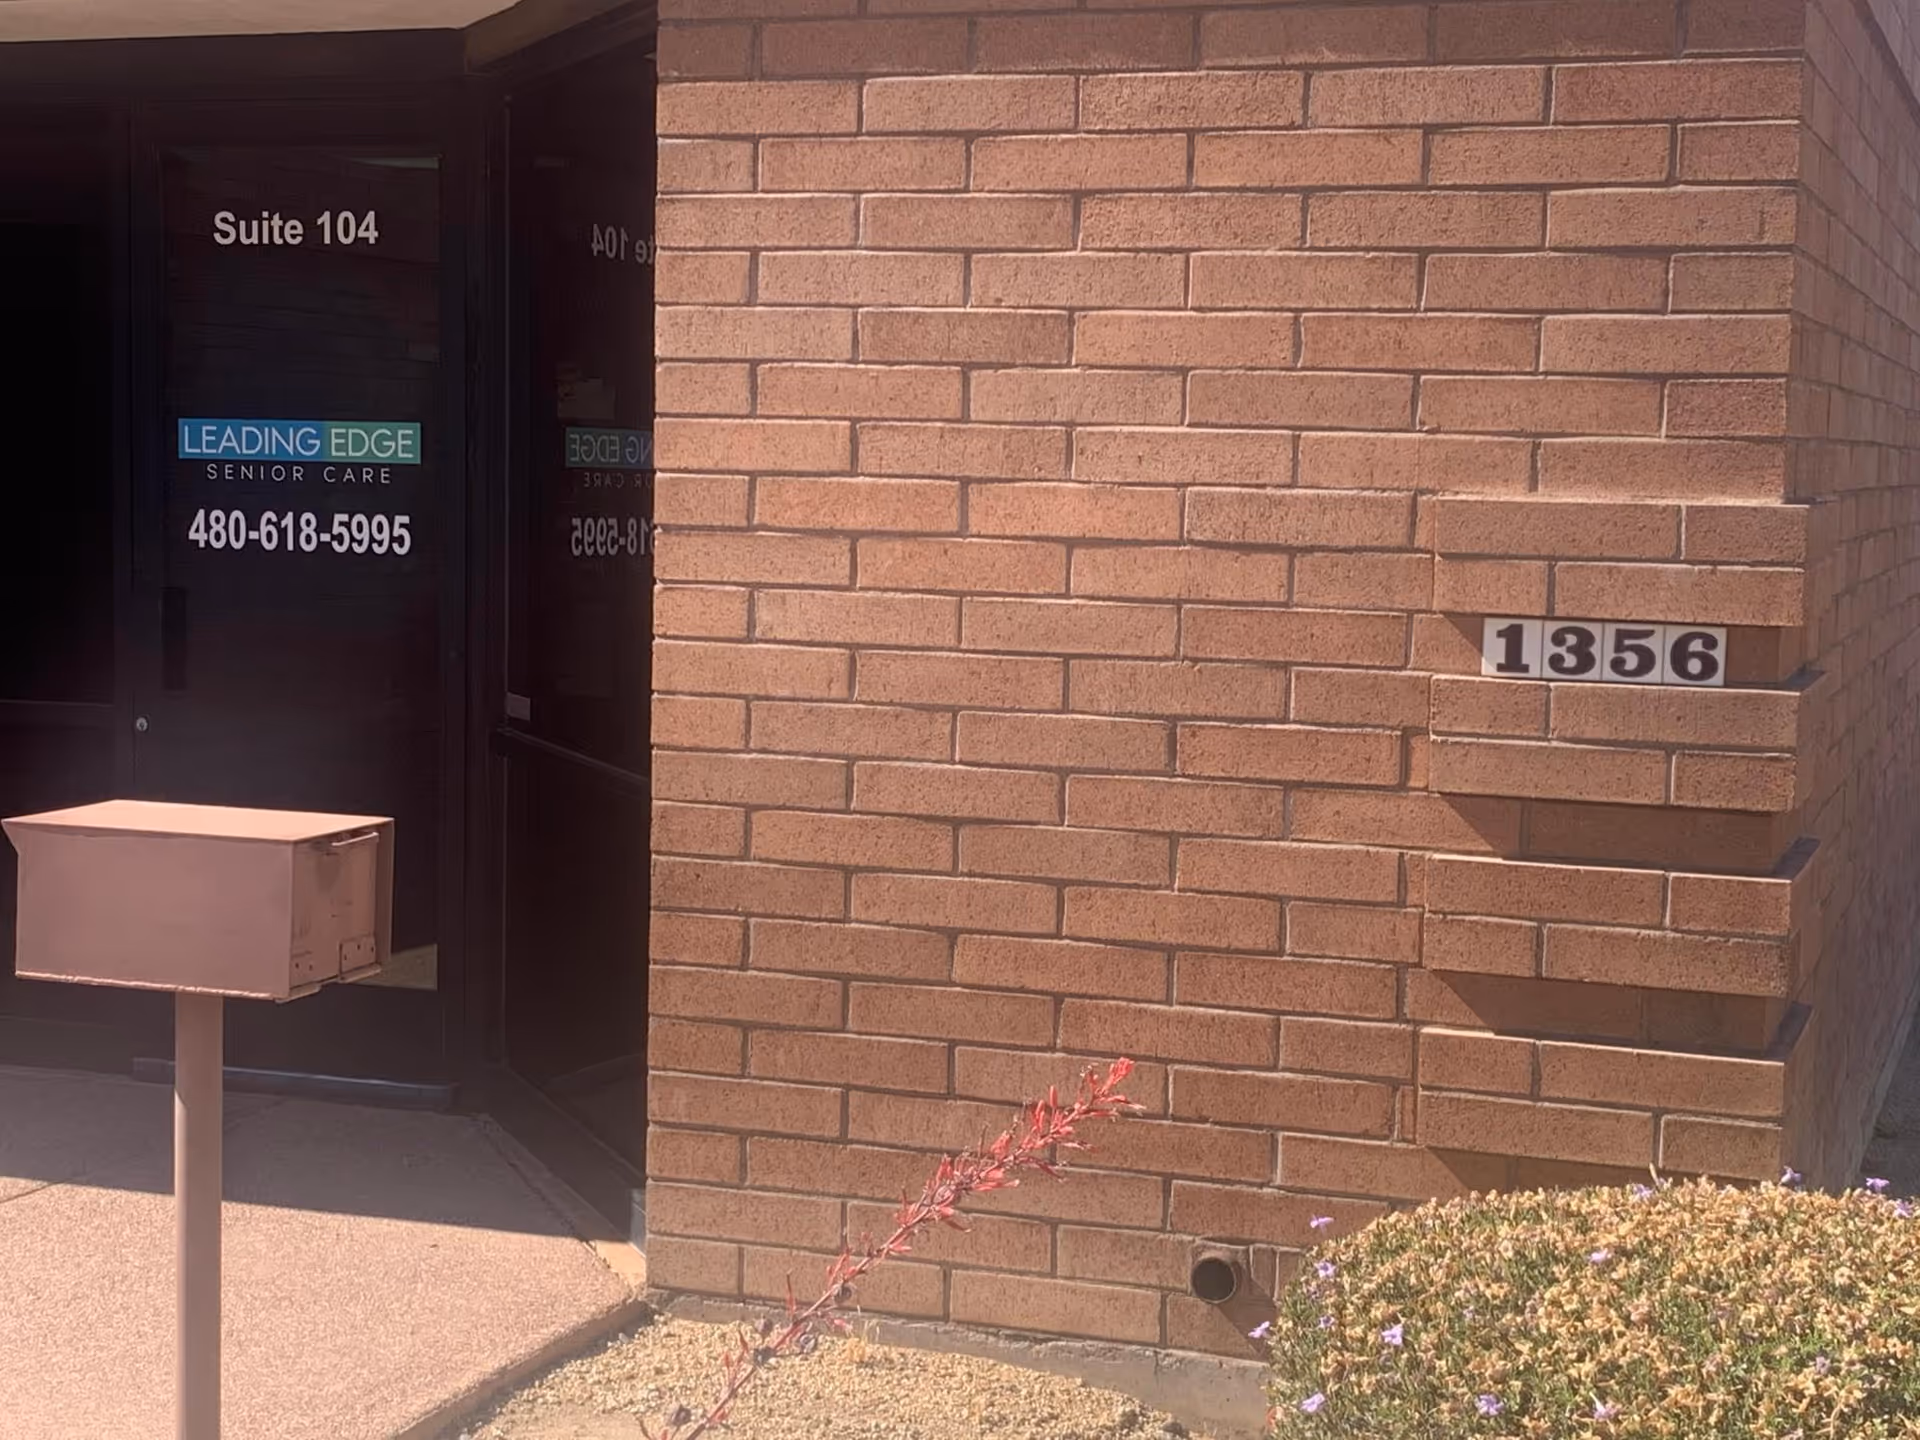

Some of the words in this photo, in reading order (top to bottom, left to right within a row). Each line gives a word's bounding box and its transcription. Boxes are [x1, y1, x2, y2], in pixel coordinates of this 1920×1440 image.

[213, 210, 304, 245] Suite
[316, 210, 379, 245] 104
[184, 425, 320, 456] LEADING
[330, 428, 414, 458] EDGE
[206, 463, 304, 482] SENIOR
[323, 466, 391, 484] CARE
[188, 508, 412, 556] 480-618-5995
[1496, 623, 1720, 682] 1356
